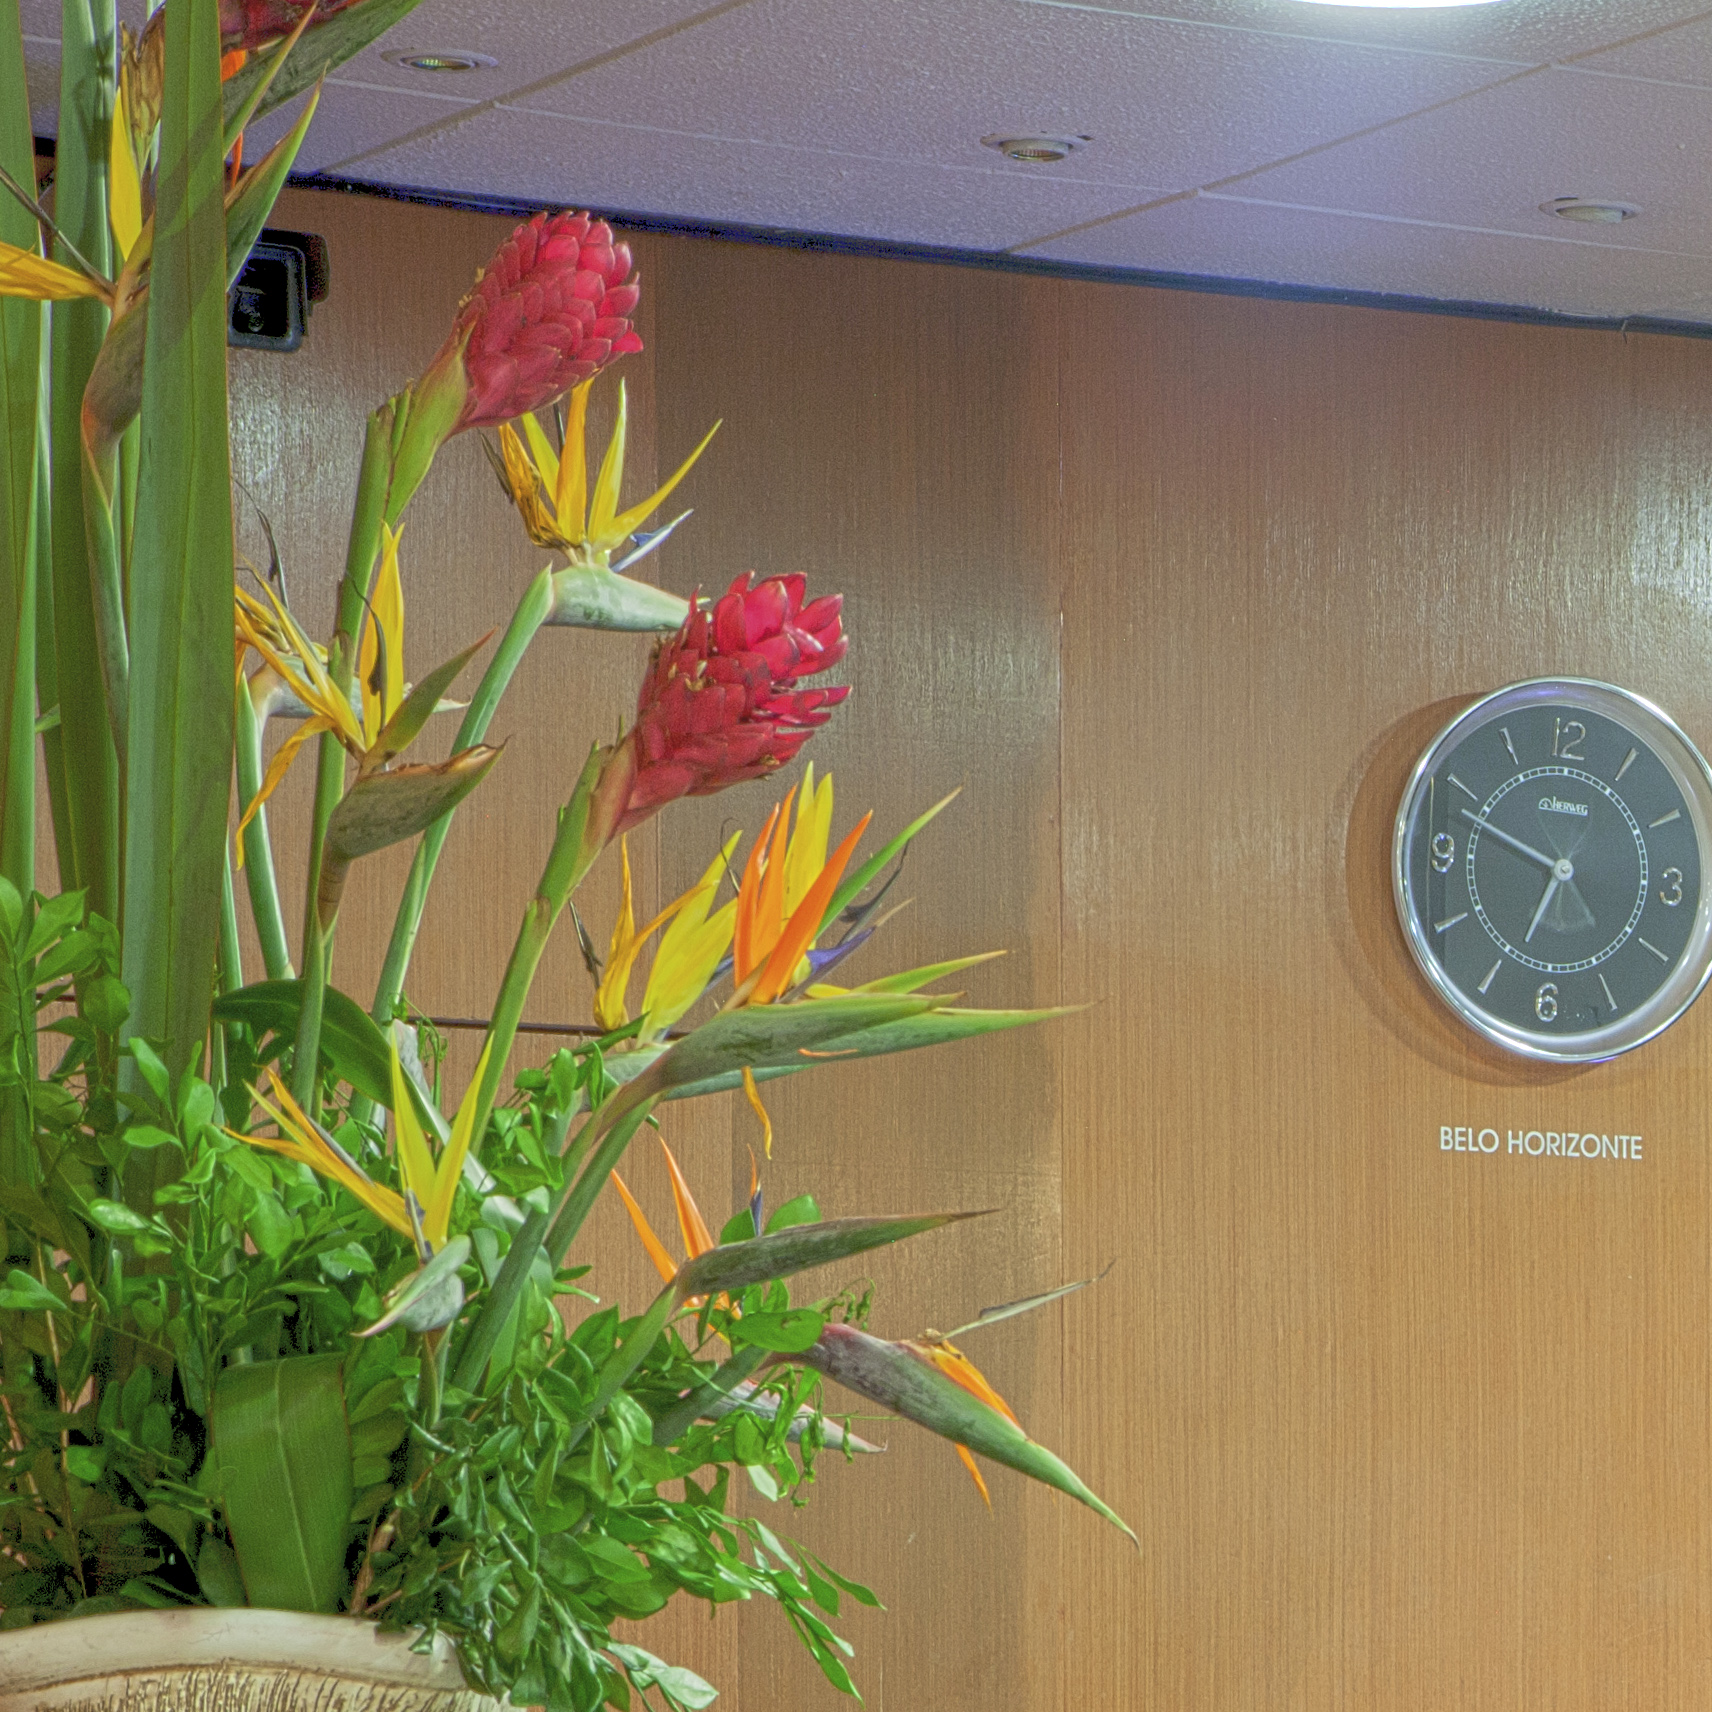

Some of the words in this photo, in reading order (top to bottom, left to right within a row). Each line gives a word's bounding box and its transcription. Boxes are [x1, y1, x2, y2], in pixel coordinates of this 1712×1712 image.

[1552, 717, 1586, 760] 12
[1431, 832, 1455, 873] 9
[1659, 866, 1683, 907] 3
[1534, 982, 1559, 1022] 6
[1440, 1126, 1499, 1154] BELO
[1508, 1130, 1643, 1160] HORIZONTE
